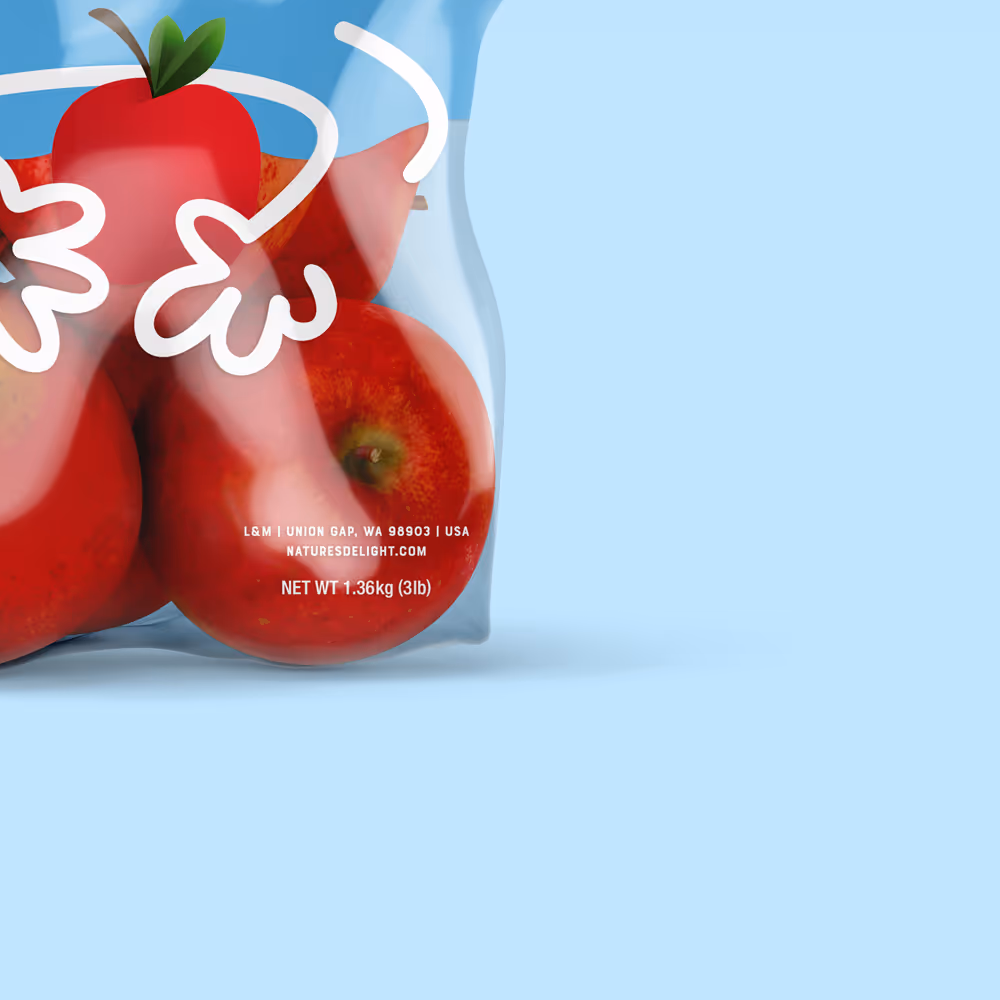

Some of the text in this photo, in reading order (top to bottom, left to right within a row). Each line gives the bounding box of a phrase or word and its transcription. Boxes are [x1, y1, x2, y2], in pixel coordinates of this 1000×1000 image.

[243, 525, 470, 538] L&M UNION GAP, WA 98903 USA
[286, 545, 427, 557] NATURESDELIGHT.COM
[281, 579, 432, 598] NET WT 1.36kg (3lb)
